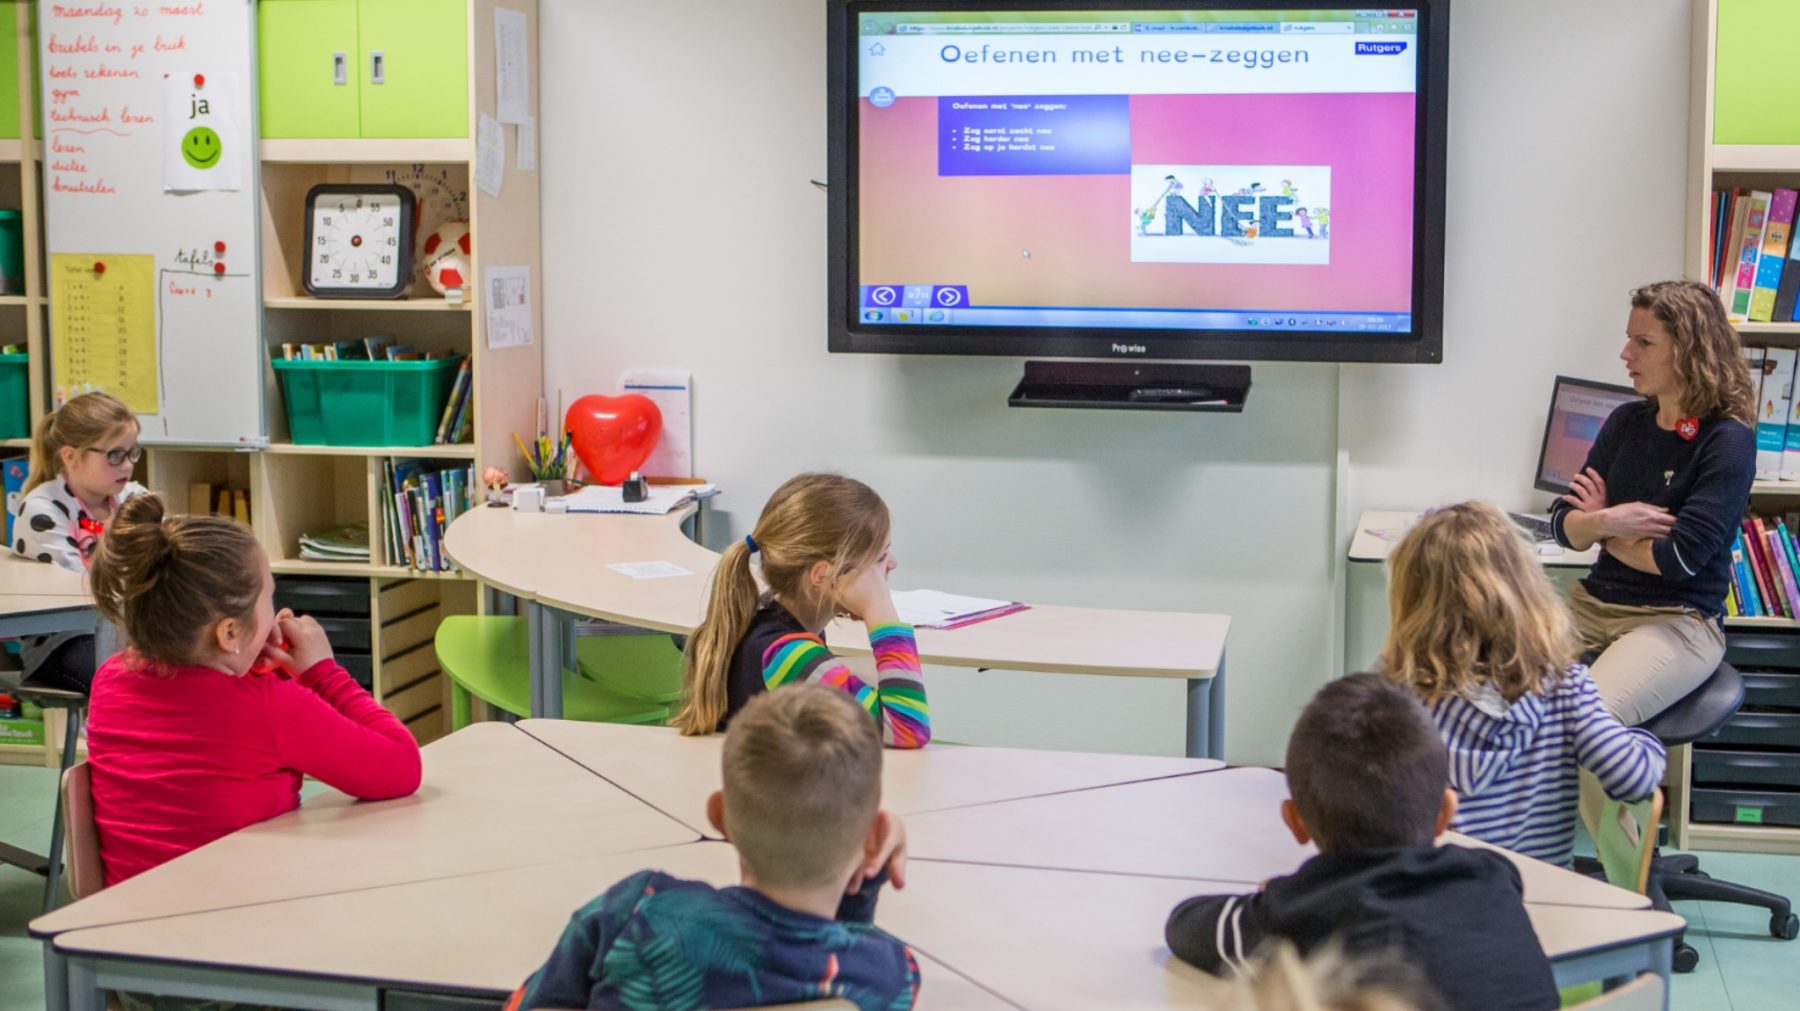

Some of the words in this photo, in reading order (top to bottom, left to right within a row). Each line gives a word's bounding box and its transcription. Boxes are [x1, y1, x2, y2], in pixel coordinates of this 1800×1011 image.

[1358, 43, 1401, 54] Rutgers
[940, 44, 1057, 63] Oefenen
[1072, 45, 1124, 63] met
[1140, 49, 1309, 68] nee-zeggen
[52, 88, 79, 104] gym
[189, 94, 210, 119] ja
[963, 127, 981, 135] Zeg
[963, 135, 981, 143] Zeg
[963, 143, 981, 152] Zeg
[412, 163, 425, 173] 12
[385, 170, 396, 179] 11
[459, 191, 467, 201] 2
[339, 203, 345, 212] 5
[370, 202, 381, 212] 55
[323, 217, 332, 226] 10
[1165, 195, 1294, 238] NEE
[383, 218, 394, 227] 50
[317, 236, 326, 245] 15
[386, 237, 397, 246] 45
[174, 248, 213, 272] tafels
[319, 254, 329, 264] 20
[381, 255, 391, 265] 40
[332, 269, 342, 279] 25
[349, 274, 359, 284] 30
[368, 270, 378, 279] 35
[1112, 344, 1146, 353] Prowise
